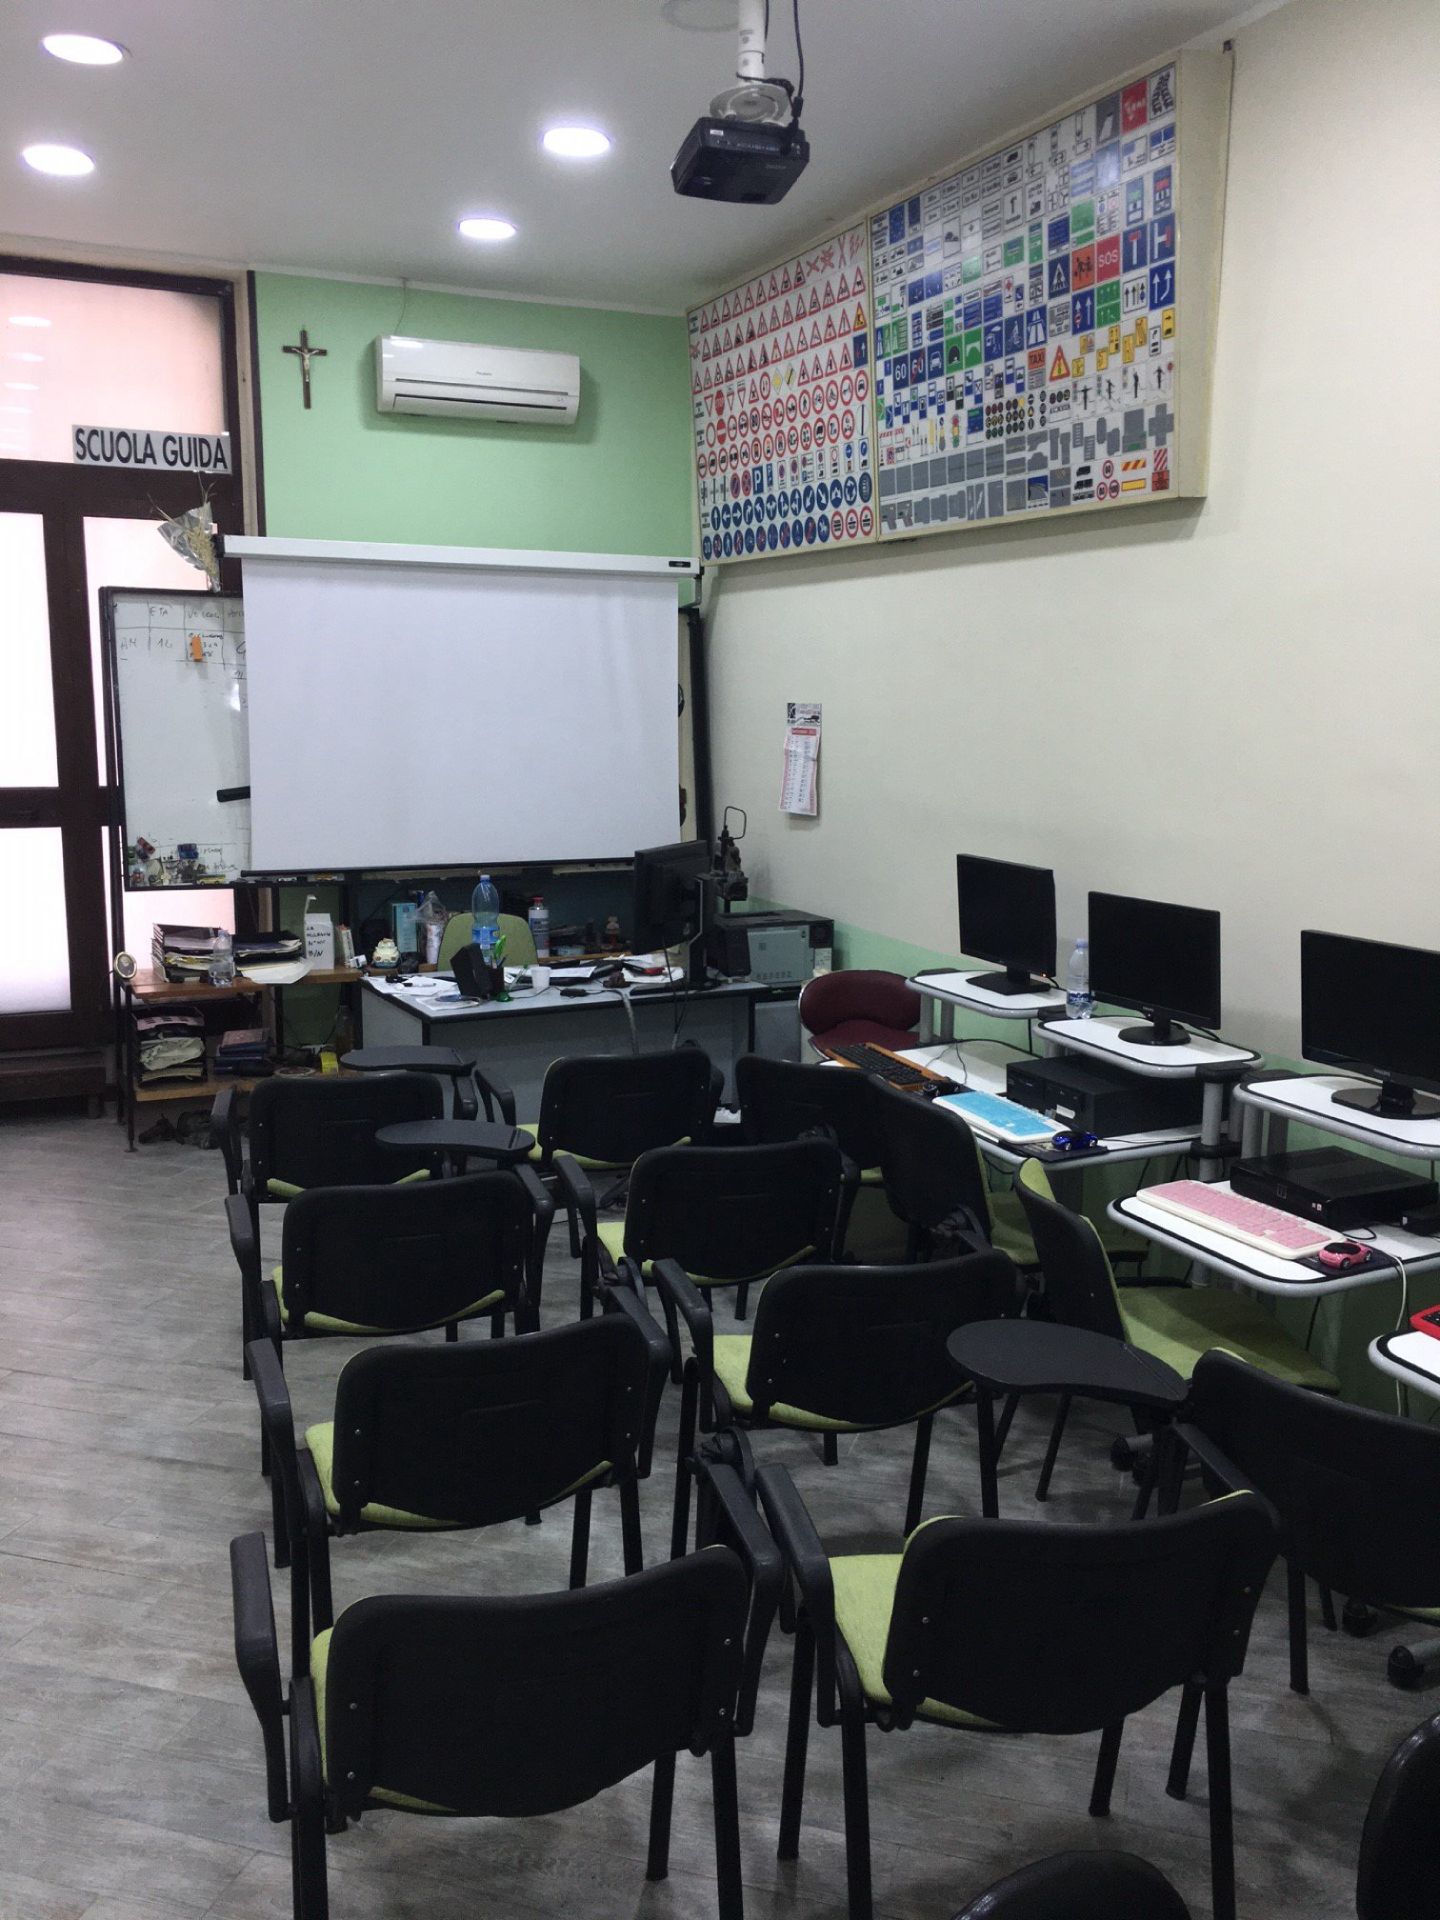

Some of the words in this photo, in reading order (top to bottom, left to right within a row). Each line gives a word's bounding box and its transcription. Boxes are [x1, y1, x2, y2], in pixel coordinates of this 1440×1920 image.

[1098, 248, 1119, 268] SOS
[1029, 352, 1046, 364] TAXI
[895, 363, 907, 381] 60
[75, 428, 157, 465] SCUOLA
[162, 435, 228, 469] GUIDA
[754, 469, 761, 491] P
